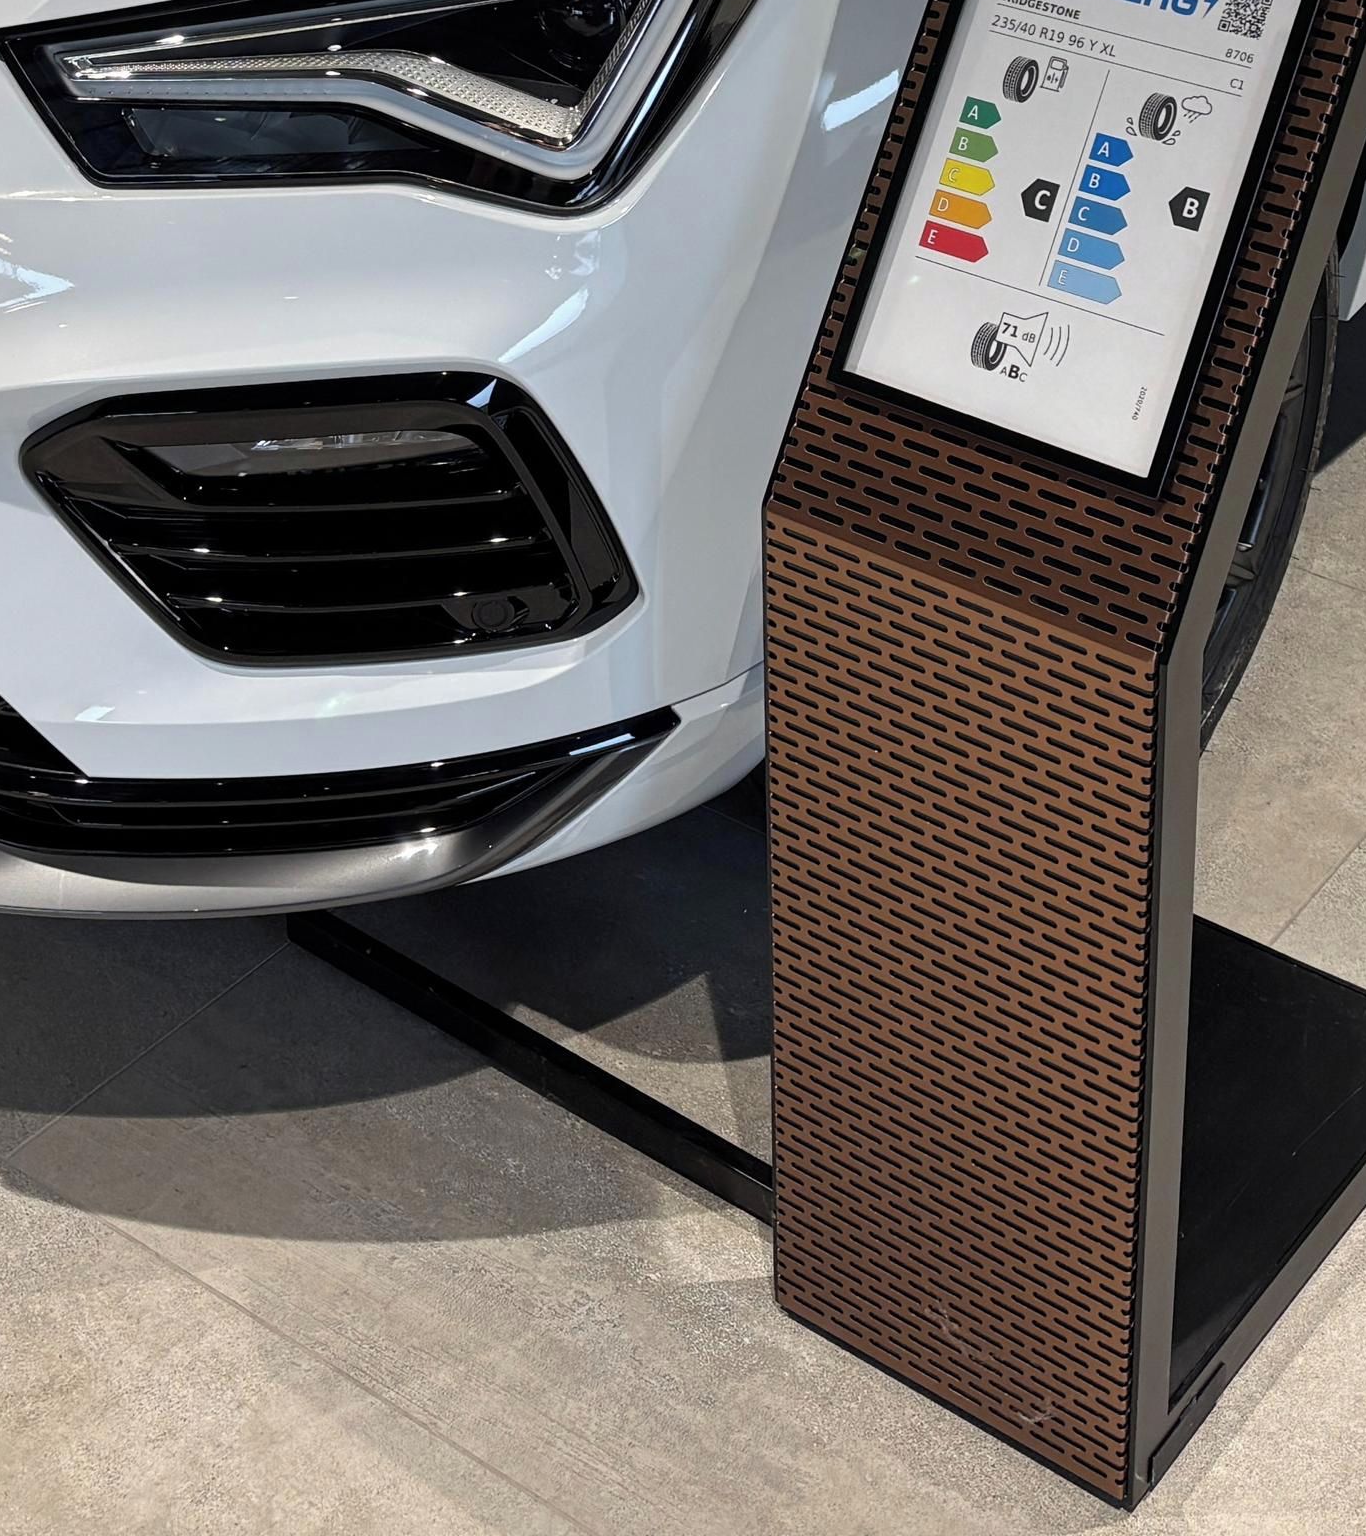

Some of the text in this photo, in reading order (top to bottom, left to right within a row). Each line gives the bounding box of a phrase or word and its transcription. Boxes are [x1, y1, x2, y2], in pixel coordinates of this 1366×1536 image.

[991, 14, 1116, 58] 235/40 R19 96 Y XL
[1225, 48, 1255, 64] 8706
[1229, 78, 1245, 91] C1
[967, 105, 979, 121] A
[958, 136, 968, 151] B
[1097, 142, 1110, 158] A
[948, 167, 960, 183] C
[1088, 174, 1100, 189] B
[937, 198, 949, 212] D
[1034, 189, 1051, 211] C
[1182, 197, 1200, 219] B
[1078, 206, 1090, 221] C
[927, 229, 938, 245] E
[1067, 238, 1080, 252] D
[1057, 270, 1068, 285] E
[1001, 322, 1036, 343] 71 dB
[1131, 386, 1148, 421] 2020/740
